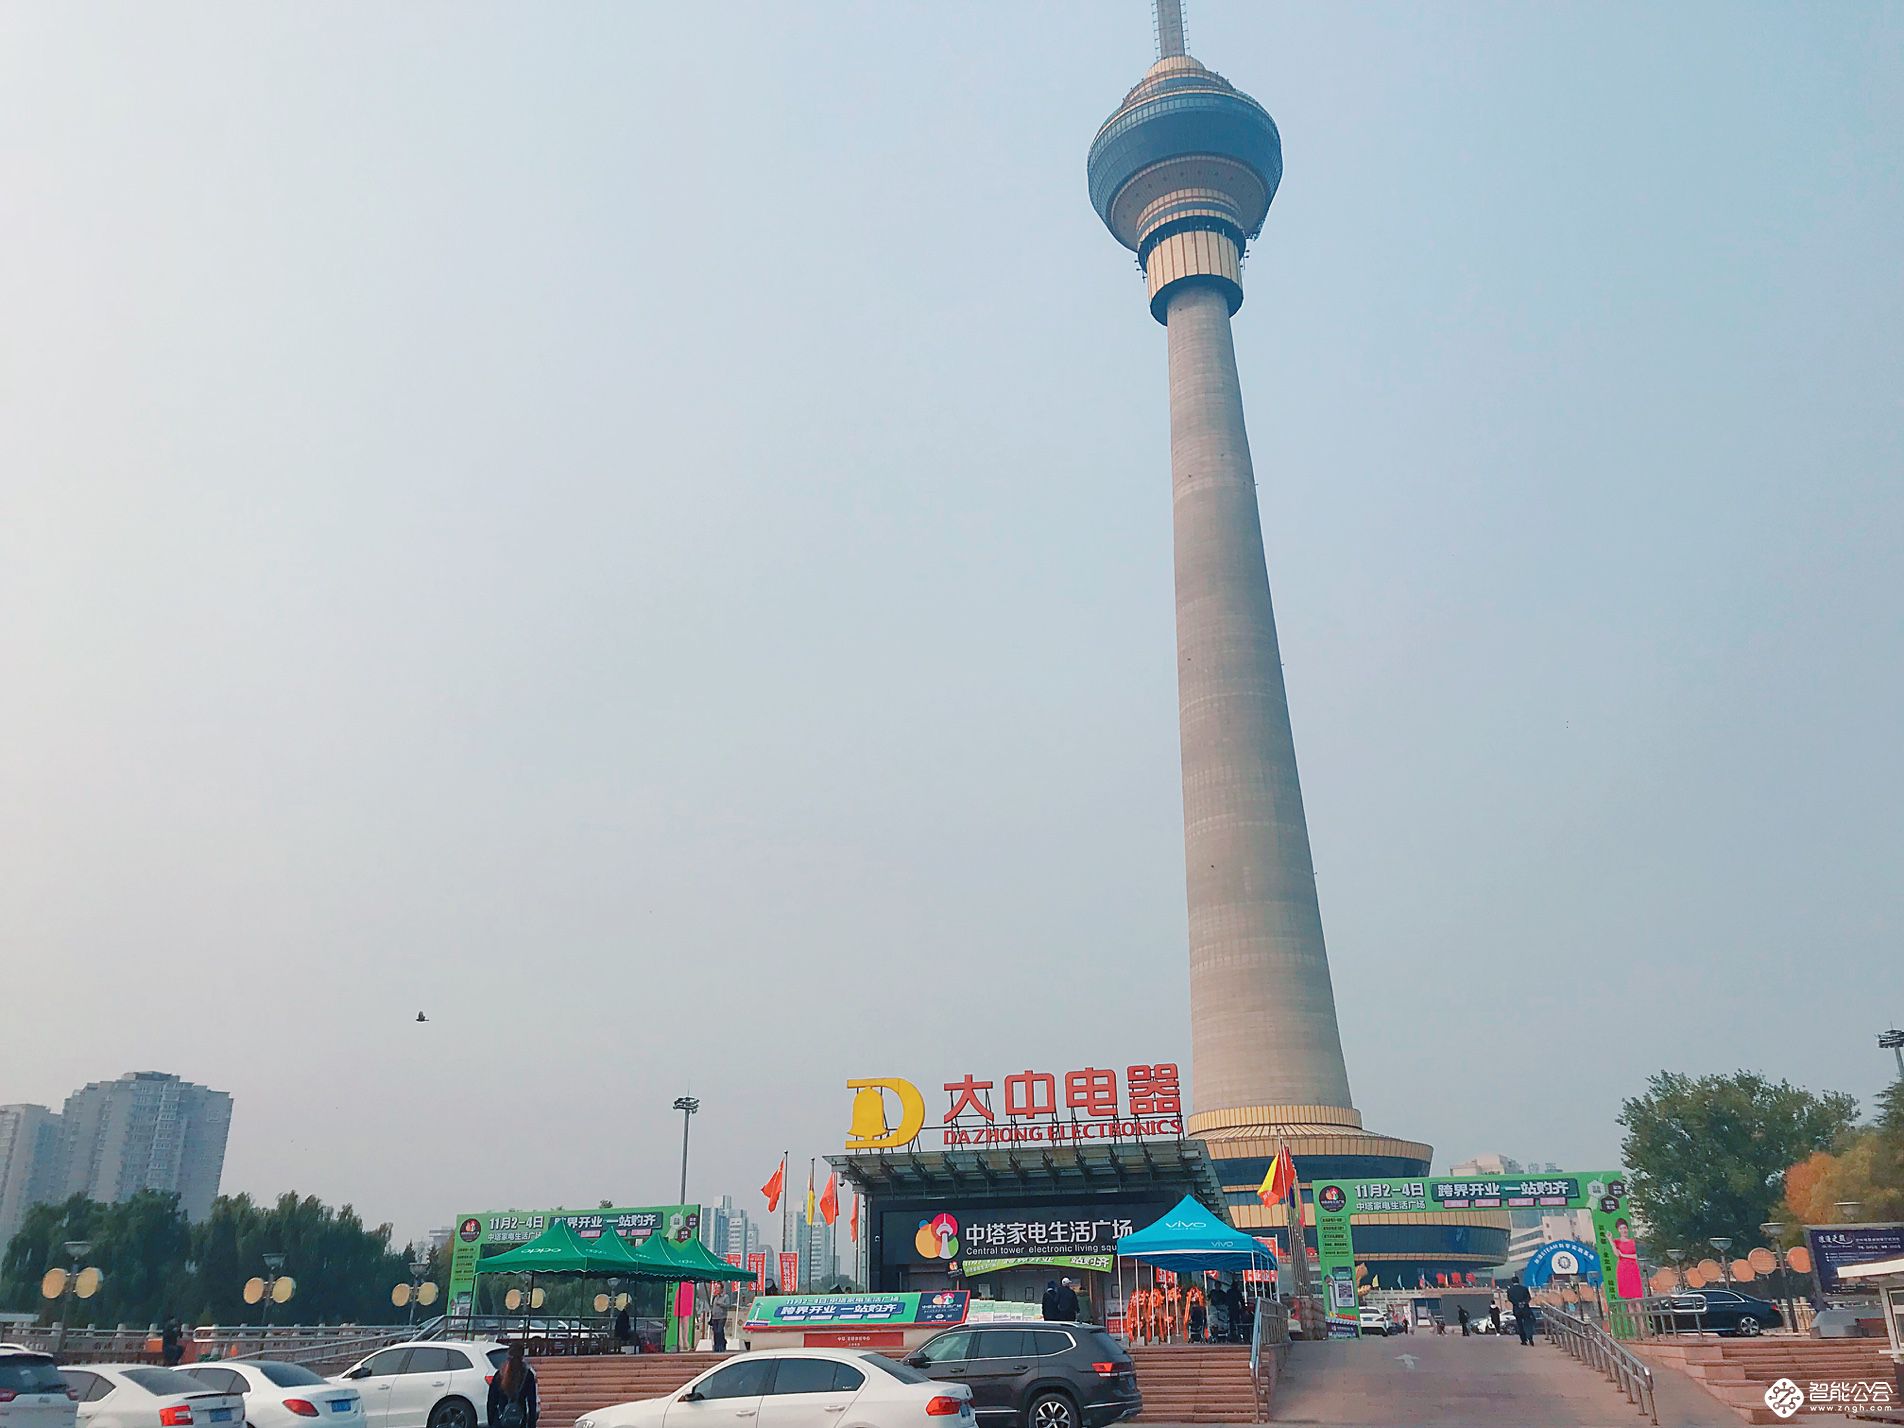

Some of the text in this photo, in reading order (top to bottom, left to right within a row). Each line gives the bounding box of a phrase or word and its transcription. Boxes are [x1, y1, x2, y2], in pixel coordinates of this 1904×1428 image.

[943, 1062, 1181, 1124] 大中电器
[943, 1118, 1182, 1146] DAZHONG ELECTRONICS
[1437, 1179, 1570, 1198] 跨界开业 一站购齐
[1355, 1199, 1426, 1212] 中塔家电生活广场
[604, 1213, 657, 1228] 一站购齐
[1165, 1220, 1207, 1229] vivo
[965, 1219, 1134, 1246] 中塔家电生活广场
[965, 1246, 998, 1256] Central
[1000, 1246, 1025, 1255] tower
[1028, 1245, 1073, 1254] electronic
[1074, 1243, 1099, 1254] living
[1211, 1240, 1234, 1248] vivo
[780, 1303, 898, 1316] 跨界开业 一站购齐
